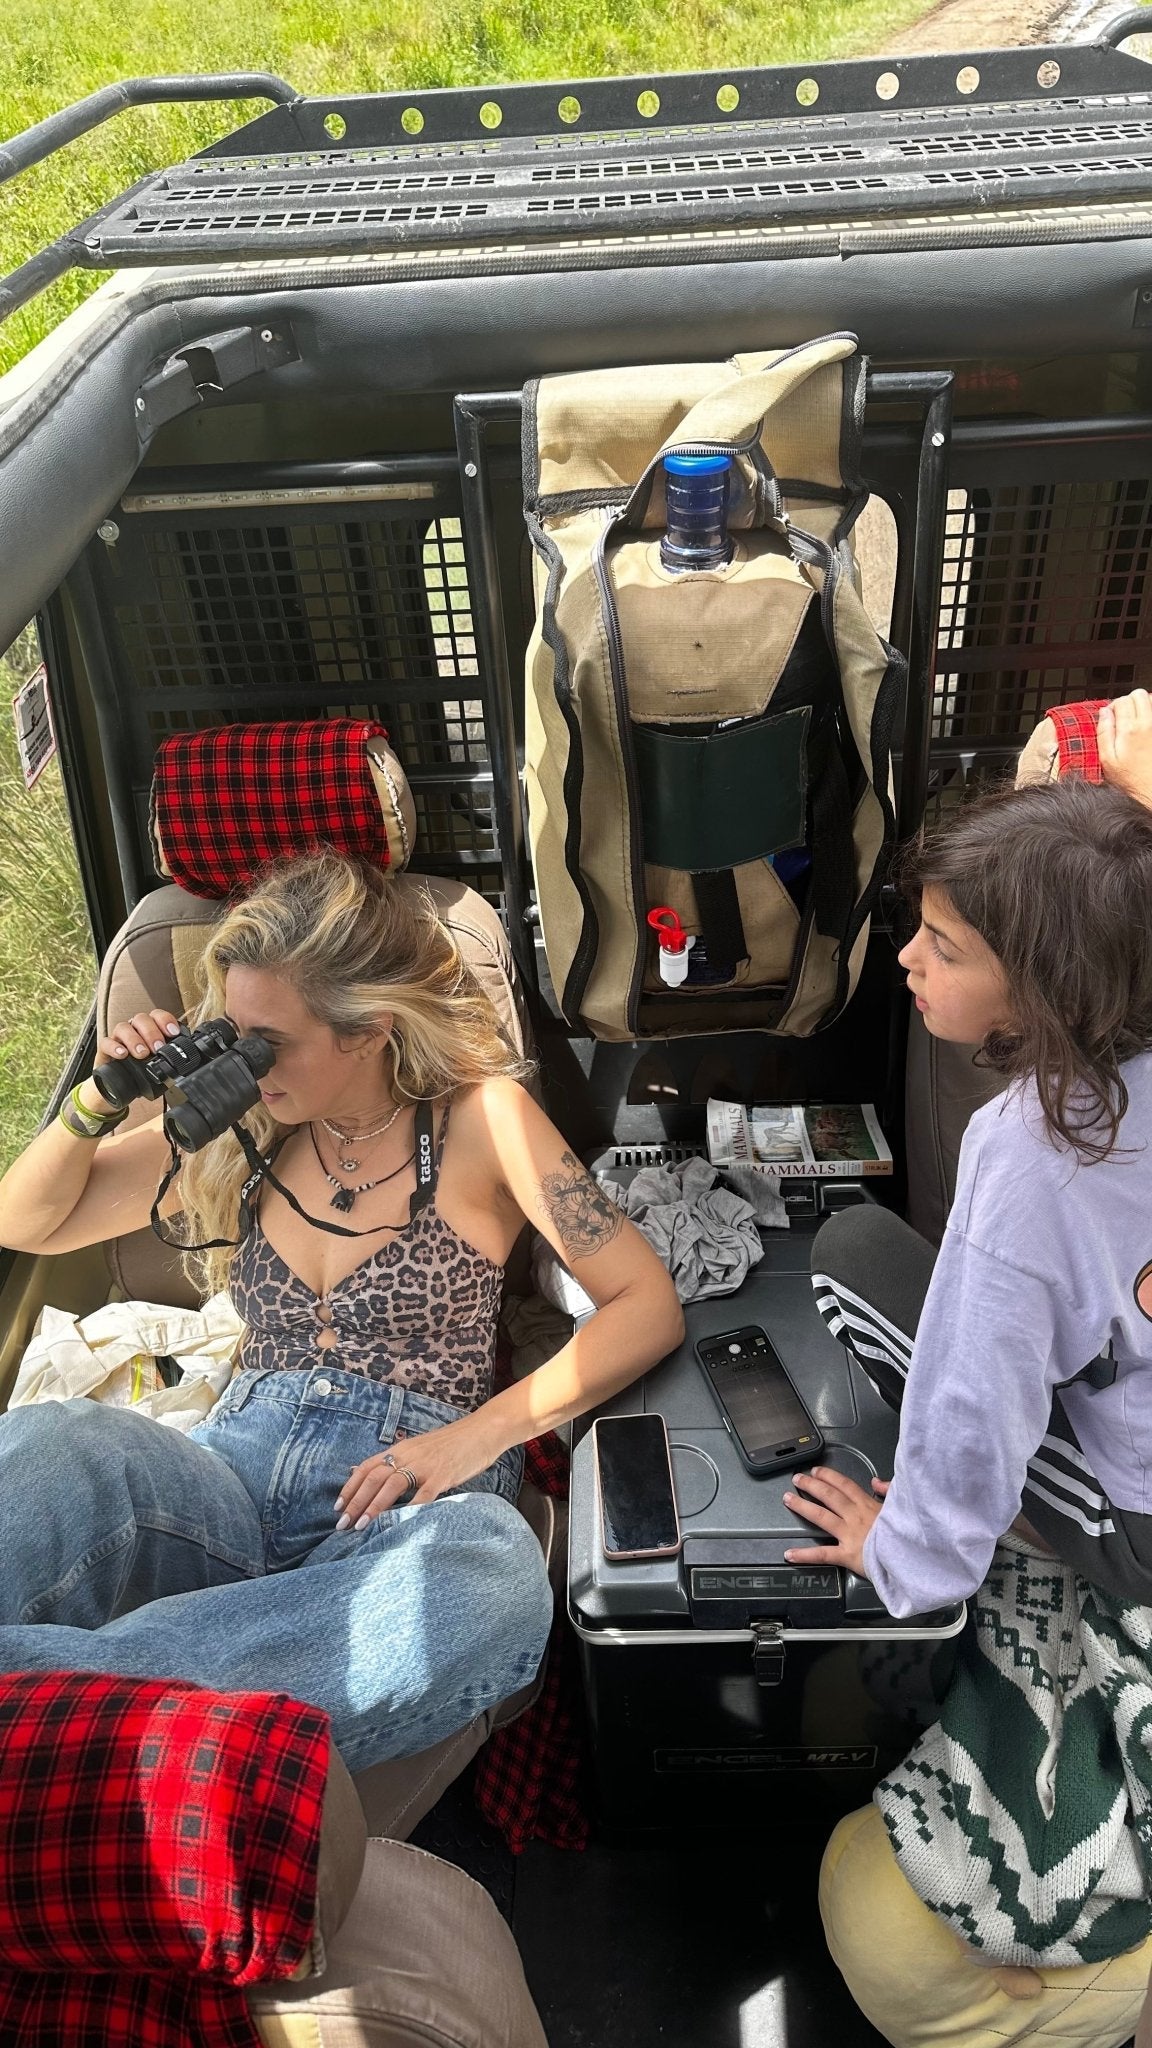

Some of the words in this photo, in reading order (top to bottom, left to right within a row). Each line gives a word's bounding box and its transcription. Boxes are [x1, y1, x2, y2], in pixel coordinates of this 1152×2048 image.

[729, 1108, 749, 1160] MAMMALS
[419, 1134, 432, 1184] tasco
[699, 1575, 788, 1589] ENGEL
[790, 1574, 832, 1588] MT-V
[667, 1754, 801, 1765] ENGEL
[806, 1752, 869, 1762] MT-V
